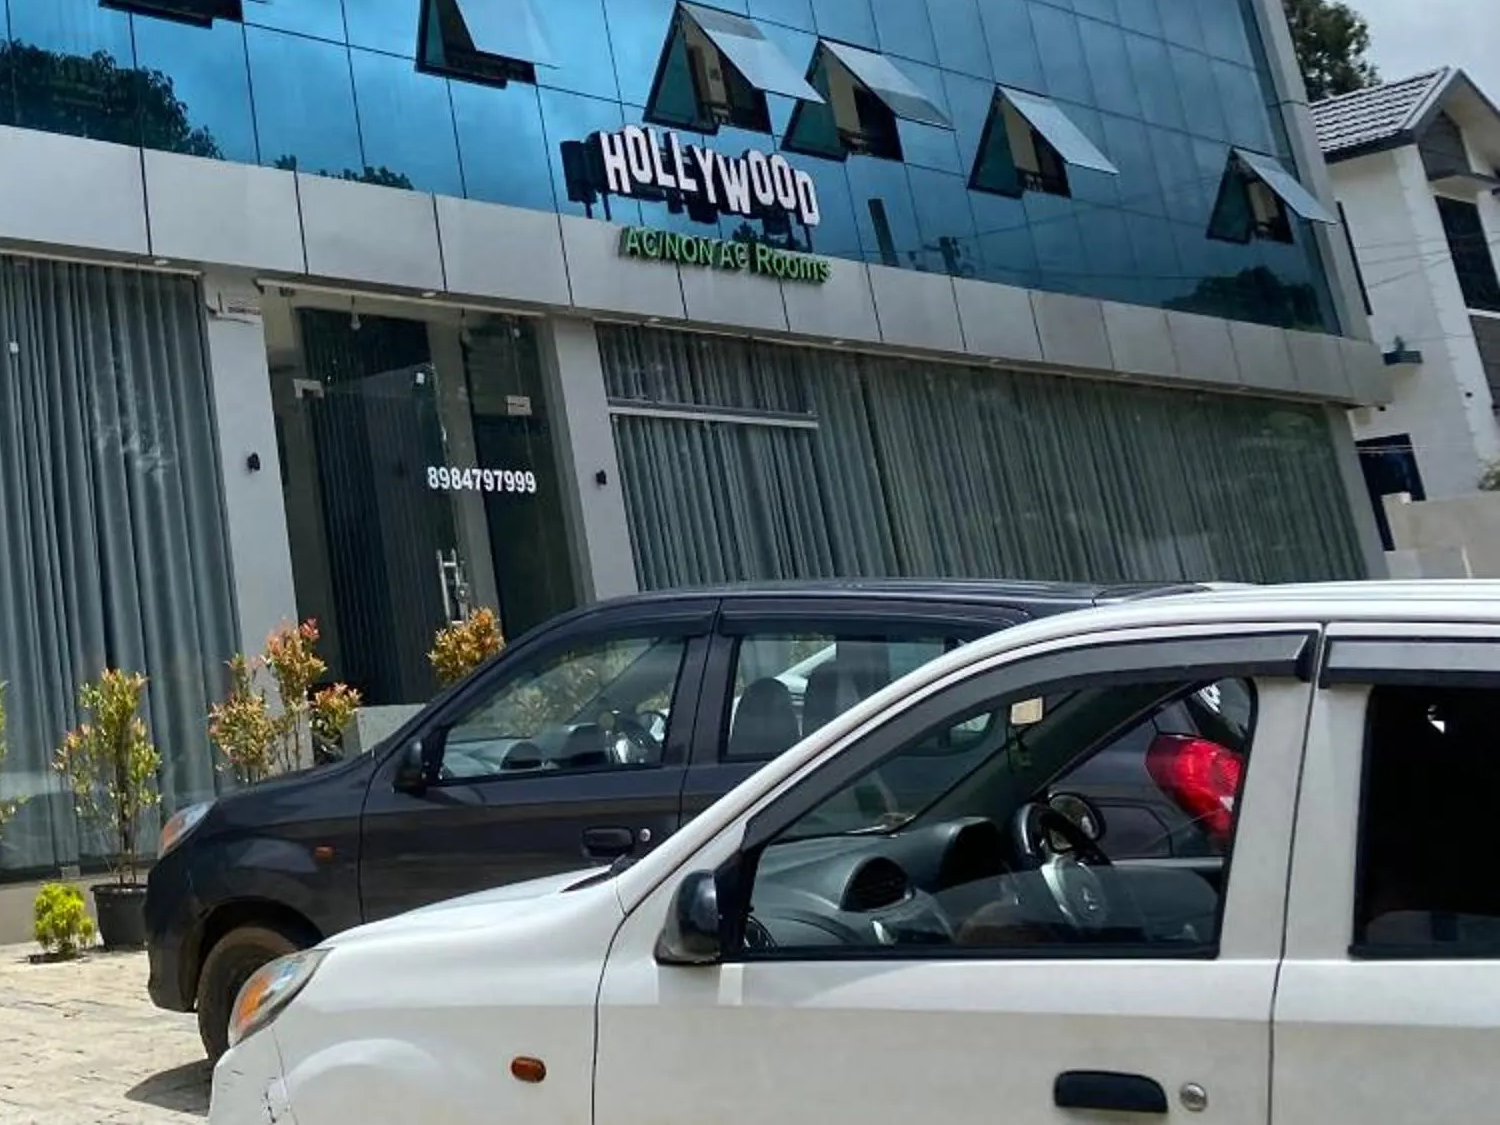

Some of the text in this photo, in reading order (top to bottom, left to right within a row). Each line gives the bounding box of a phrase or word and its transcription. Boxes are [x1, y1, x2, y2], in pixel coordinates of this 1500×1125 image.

[600, 125, 820, 226] HOLLYWOOD
[719, 241, 750, 269] AC
[756, 245, 833, 283] Rooms
[427, 466, 537, 493] 8984797999
